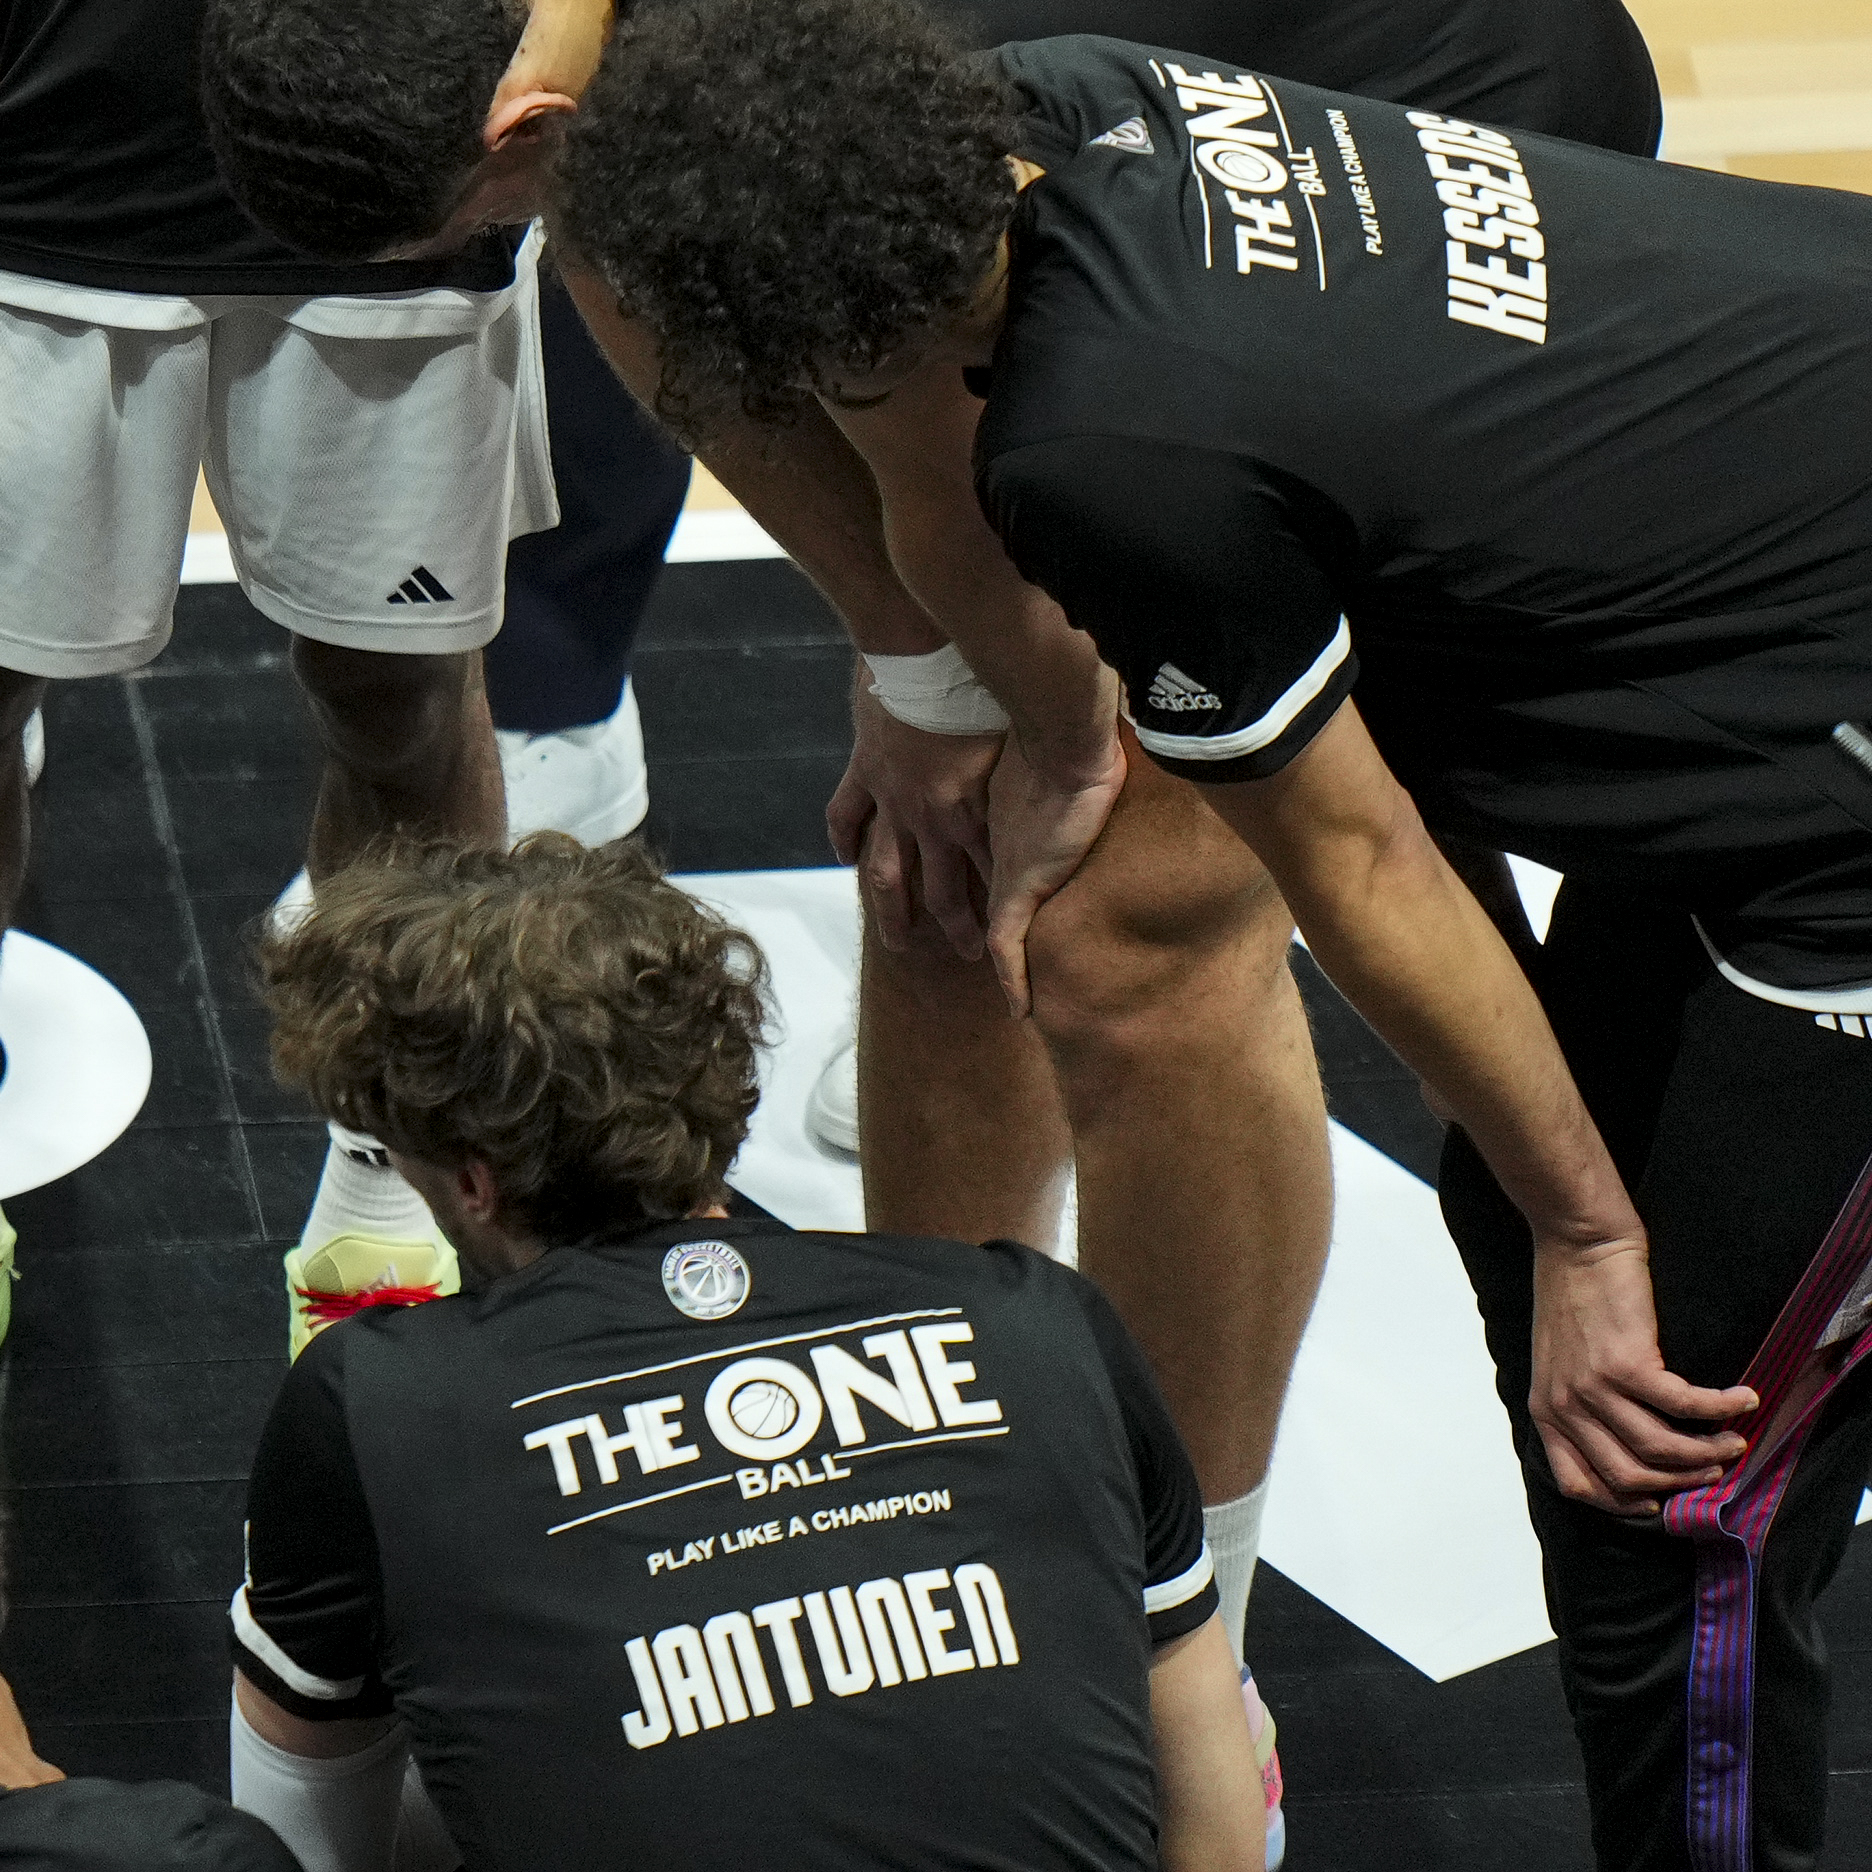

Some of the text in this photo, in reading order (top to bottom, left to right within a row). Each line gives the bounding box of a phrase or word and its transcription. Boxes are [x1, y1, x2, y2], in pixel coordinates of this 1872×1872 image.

[1164, 62, 1298, 275] THE ONE
[1287, 146, 1326, 196] BALL
[1326, 109, 1383, 256] PLAY LIKE A CHAMPION
[1405, 111, 1548, 345] KESSENS
[1148, 692, 1222, 712] adidas
[523, 1321, 1003, 1496] THE ONE
[735, 1453, 851, 1500] BALL
[646, 1488, 953, 1576] PLAY LIKE A CHAMPION
[620, 1561, 1021, 1750] JANTUNEN
